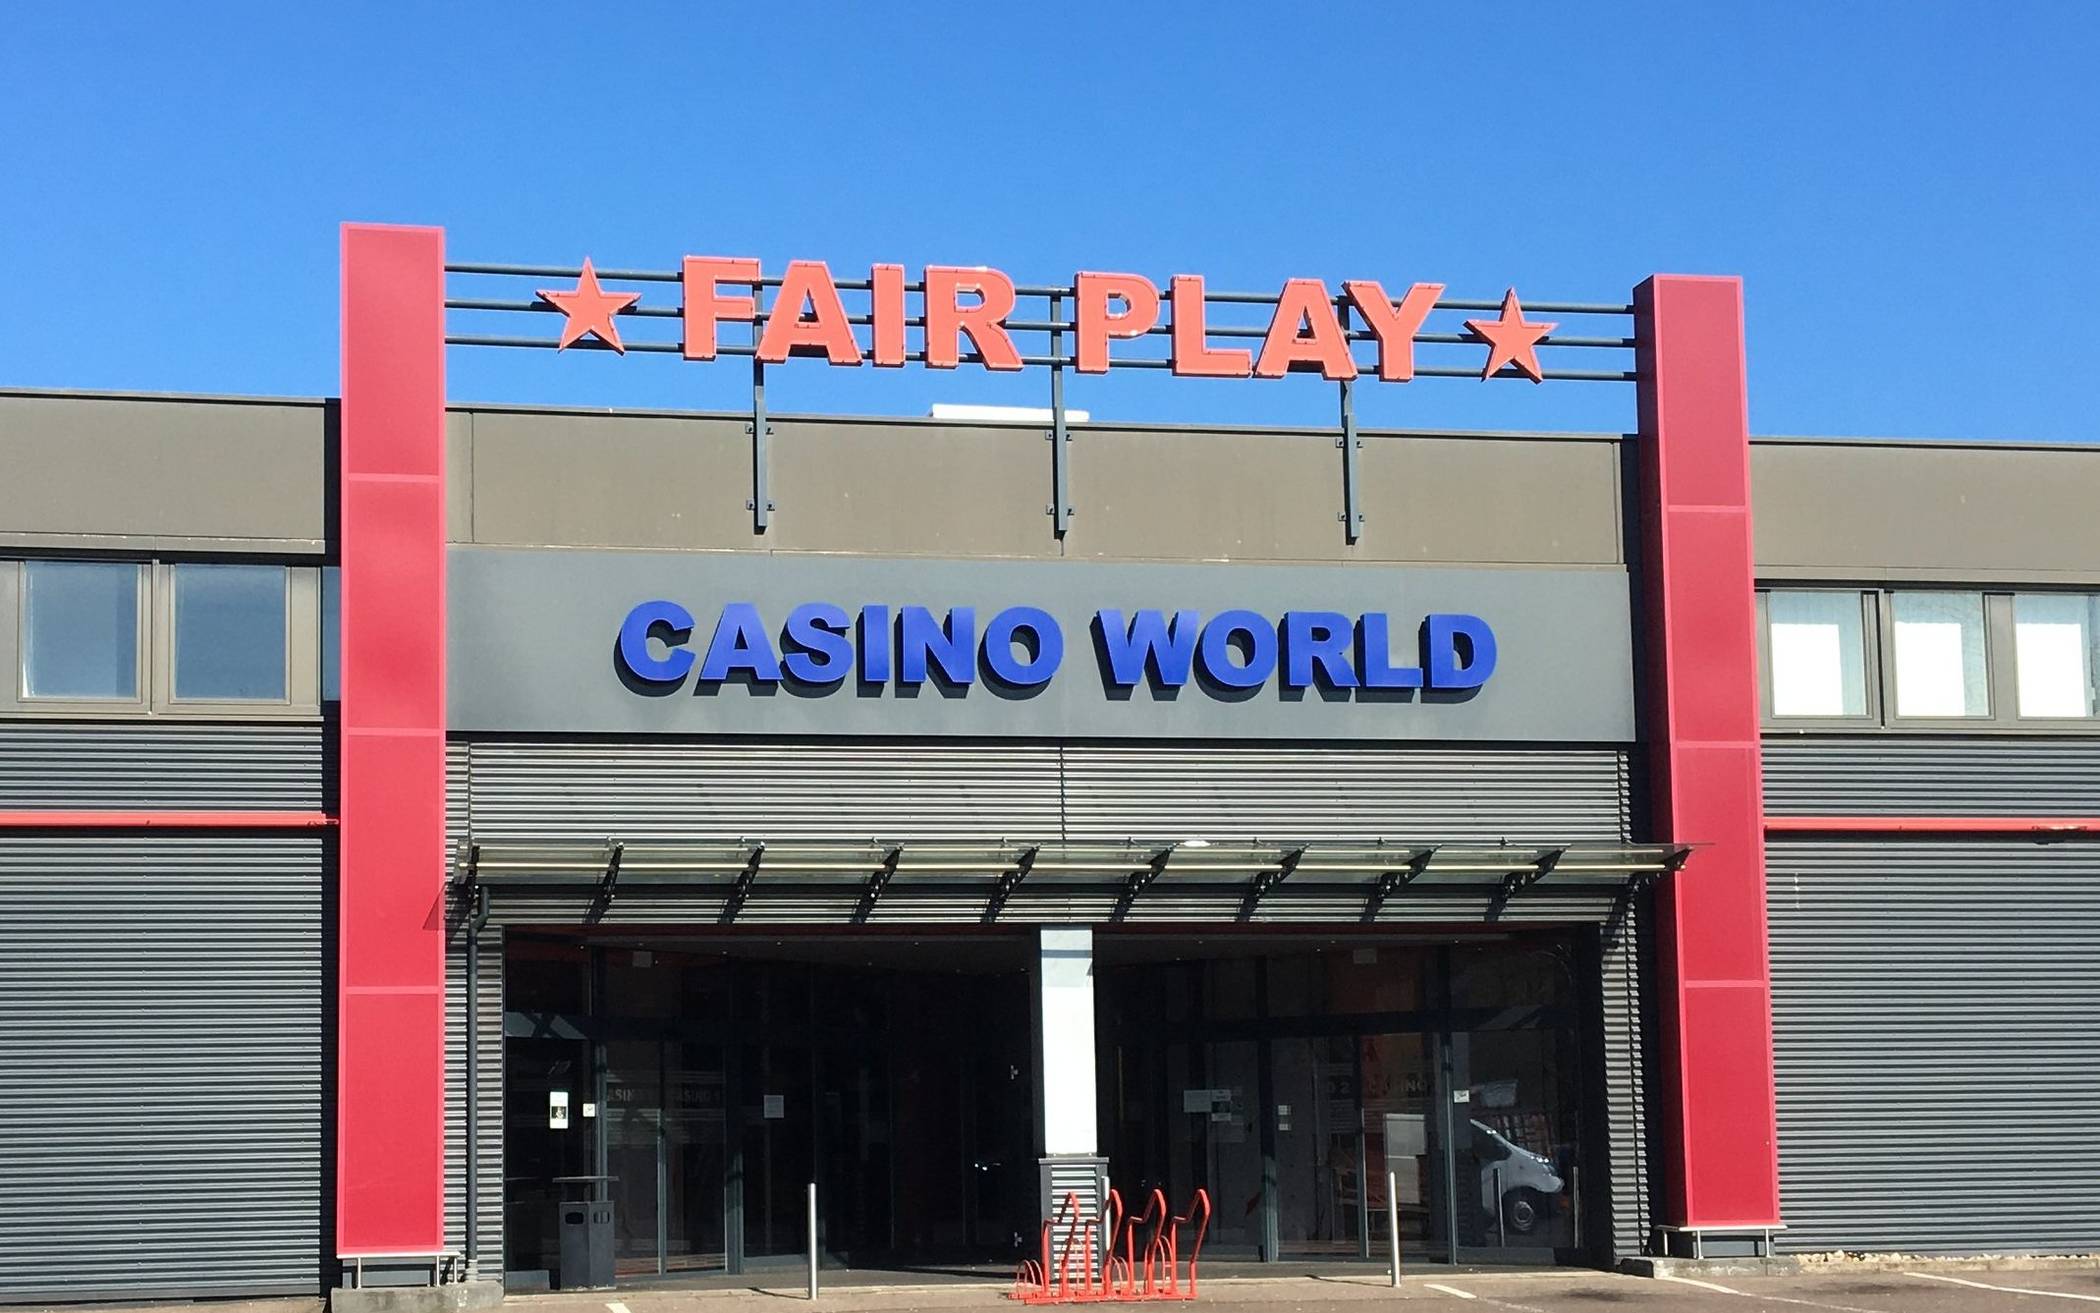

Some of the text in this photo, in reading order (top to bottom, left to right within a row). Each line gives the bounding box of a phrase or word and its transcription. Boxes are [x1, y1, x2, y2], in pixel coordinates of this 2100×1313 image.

[682, 254, 1445, 384] FAIR PLAY
[617, 600, 1498, 698] CASINO WORLD
